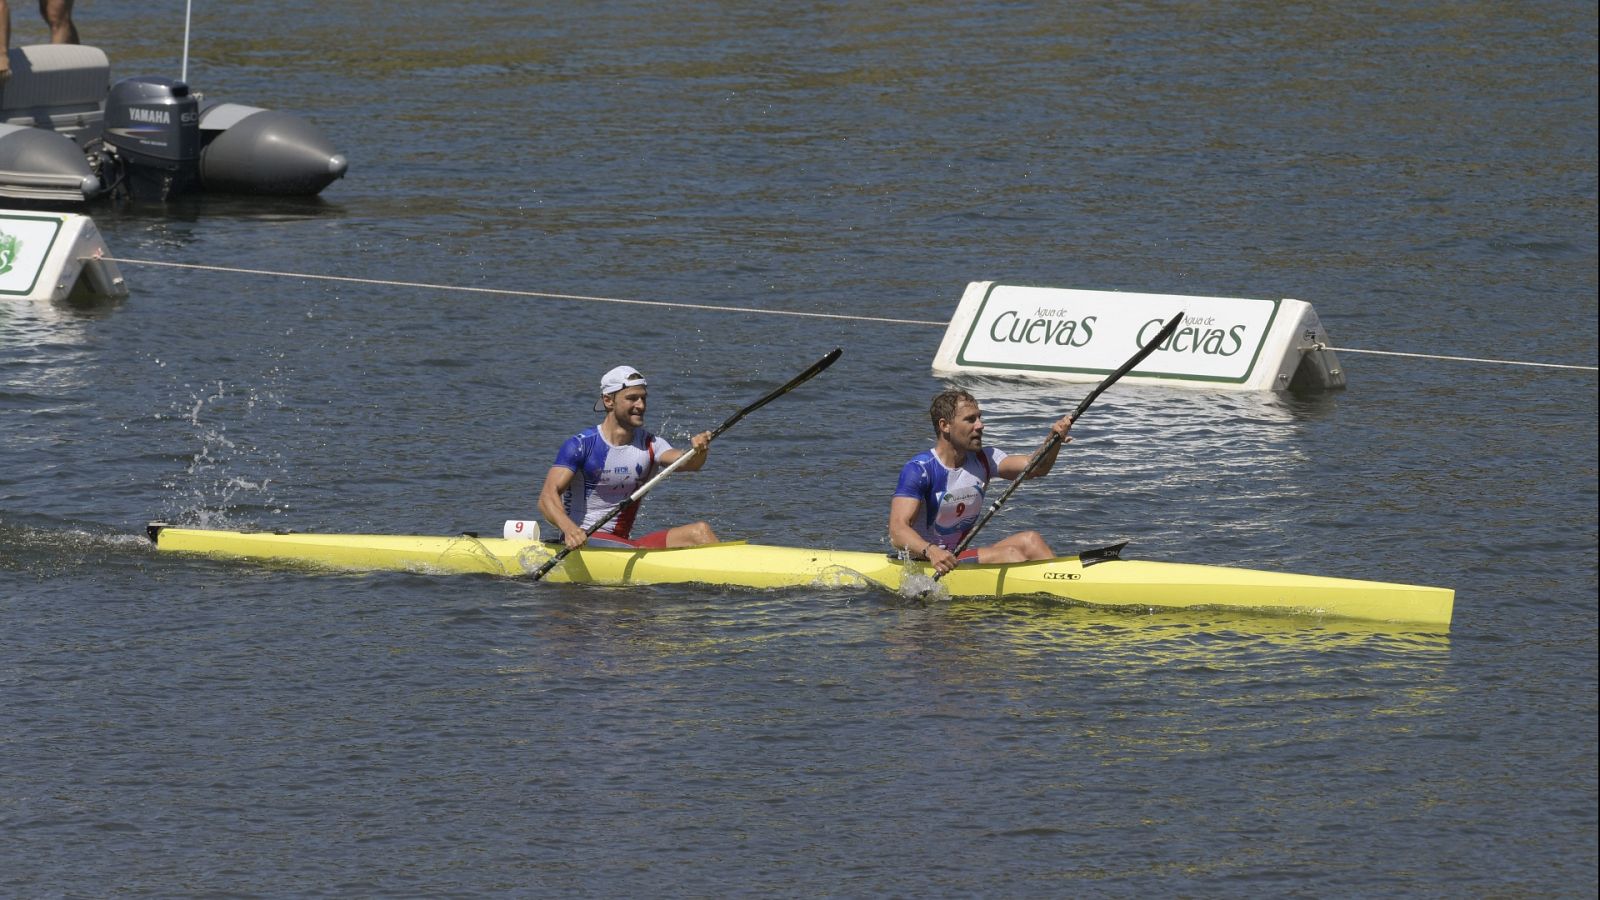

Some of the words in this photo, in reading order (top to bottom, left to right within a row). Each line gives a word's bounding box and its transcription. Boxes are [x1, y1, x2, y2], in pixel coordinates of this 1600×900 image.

[129, 107, 171, 124] YAMAHA
[955, 502, 966, 518] 9
[514, 521, 525, 534] 9
